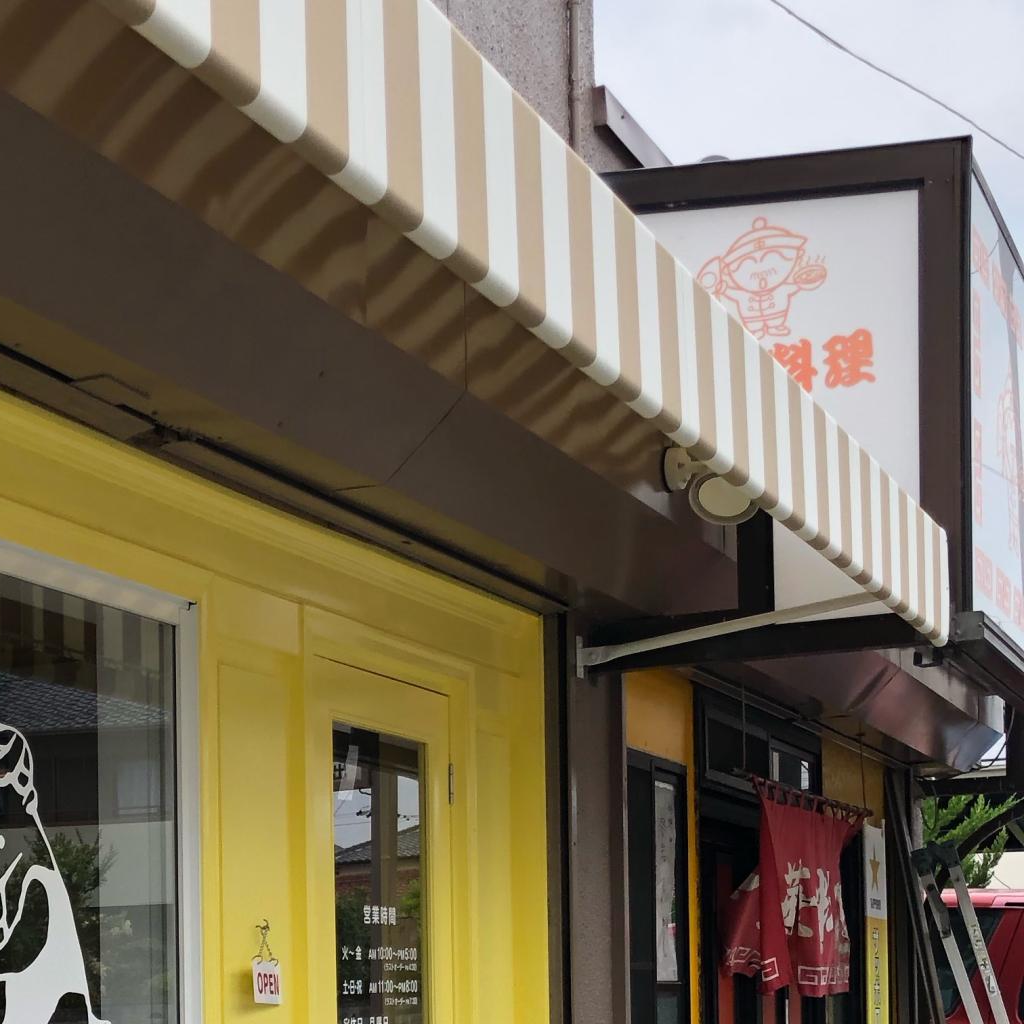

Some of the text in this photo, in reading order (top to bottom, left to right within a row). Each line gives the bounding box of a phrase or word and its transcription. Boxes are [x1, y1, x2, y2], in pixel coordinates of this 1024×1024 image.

[363, 905, 396, 926] 営業時間
[257, 972, 280, 995] OPEN
